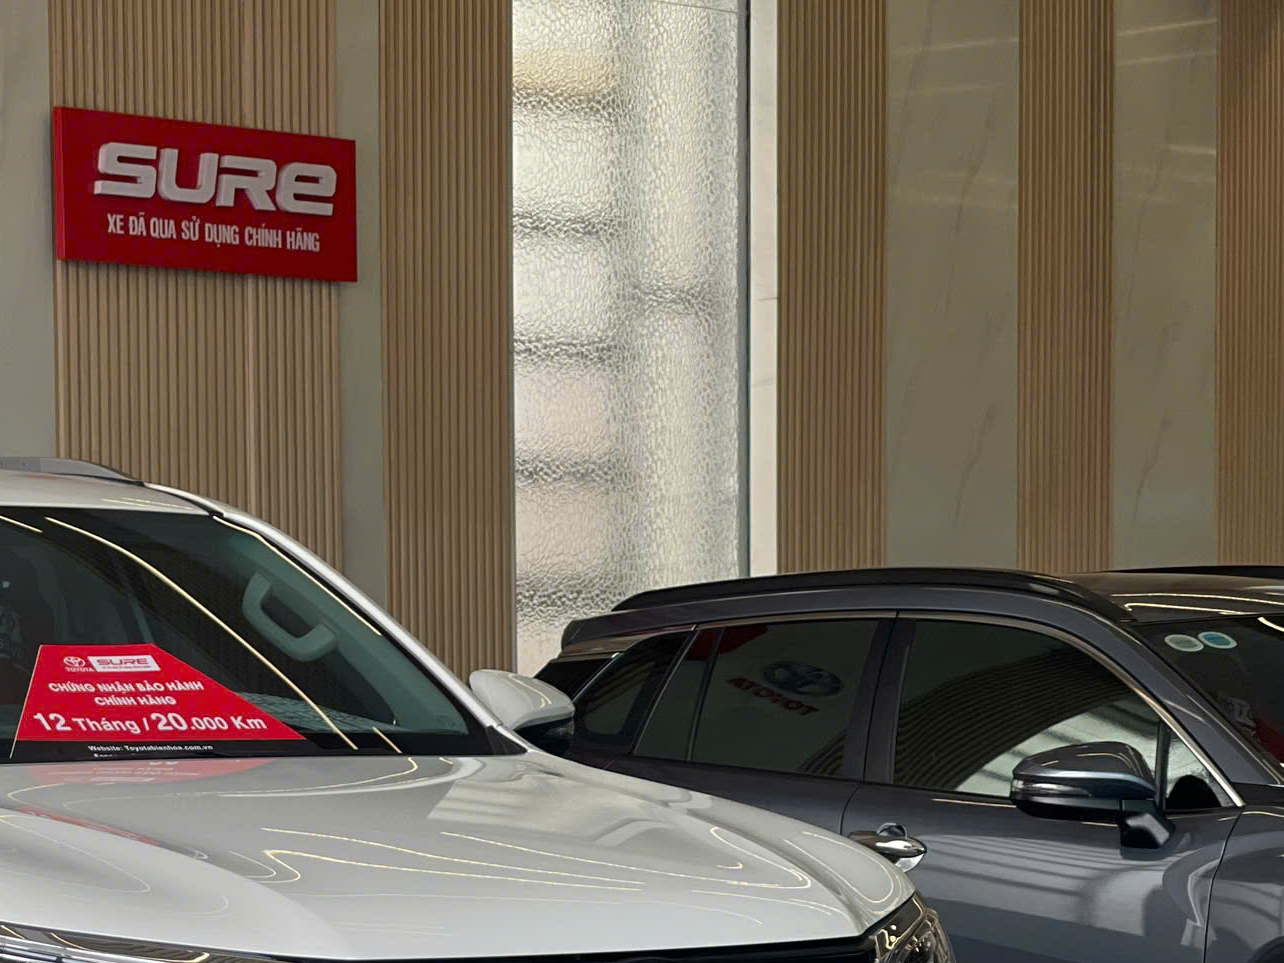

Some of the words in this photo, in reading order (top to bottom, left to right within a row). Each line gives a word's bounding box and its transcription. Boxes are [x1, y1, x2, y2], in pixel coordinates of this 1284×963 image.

[107, 213, 124, 234] XE
[129, 211, 146, 236] ĐÃ
[150, 217, 177, 239] QUA
[181, 215, 200, 241] SỬ
[205, 223, 239, 248] DỤNG
[244, 223, 282, 248] CHÍNH
[286, 227, 320, 252] HÃNG
[97, 658, 149, 666] SURE
[97, 680, 136, 694] NHẬN
[136, 680, 165, 692] BẢO
[165, 680, 205, 691] HÀNH
[94, 695, 137, 706] CHÍNH
[33, 712, 72, 732] 12
[71, 717, 141, 735] Tháng
[230, 716, 268, 730] Km
